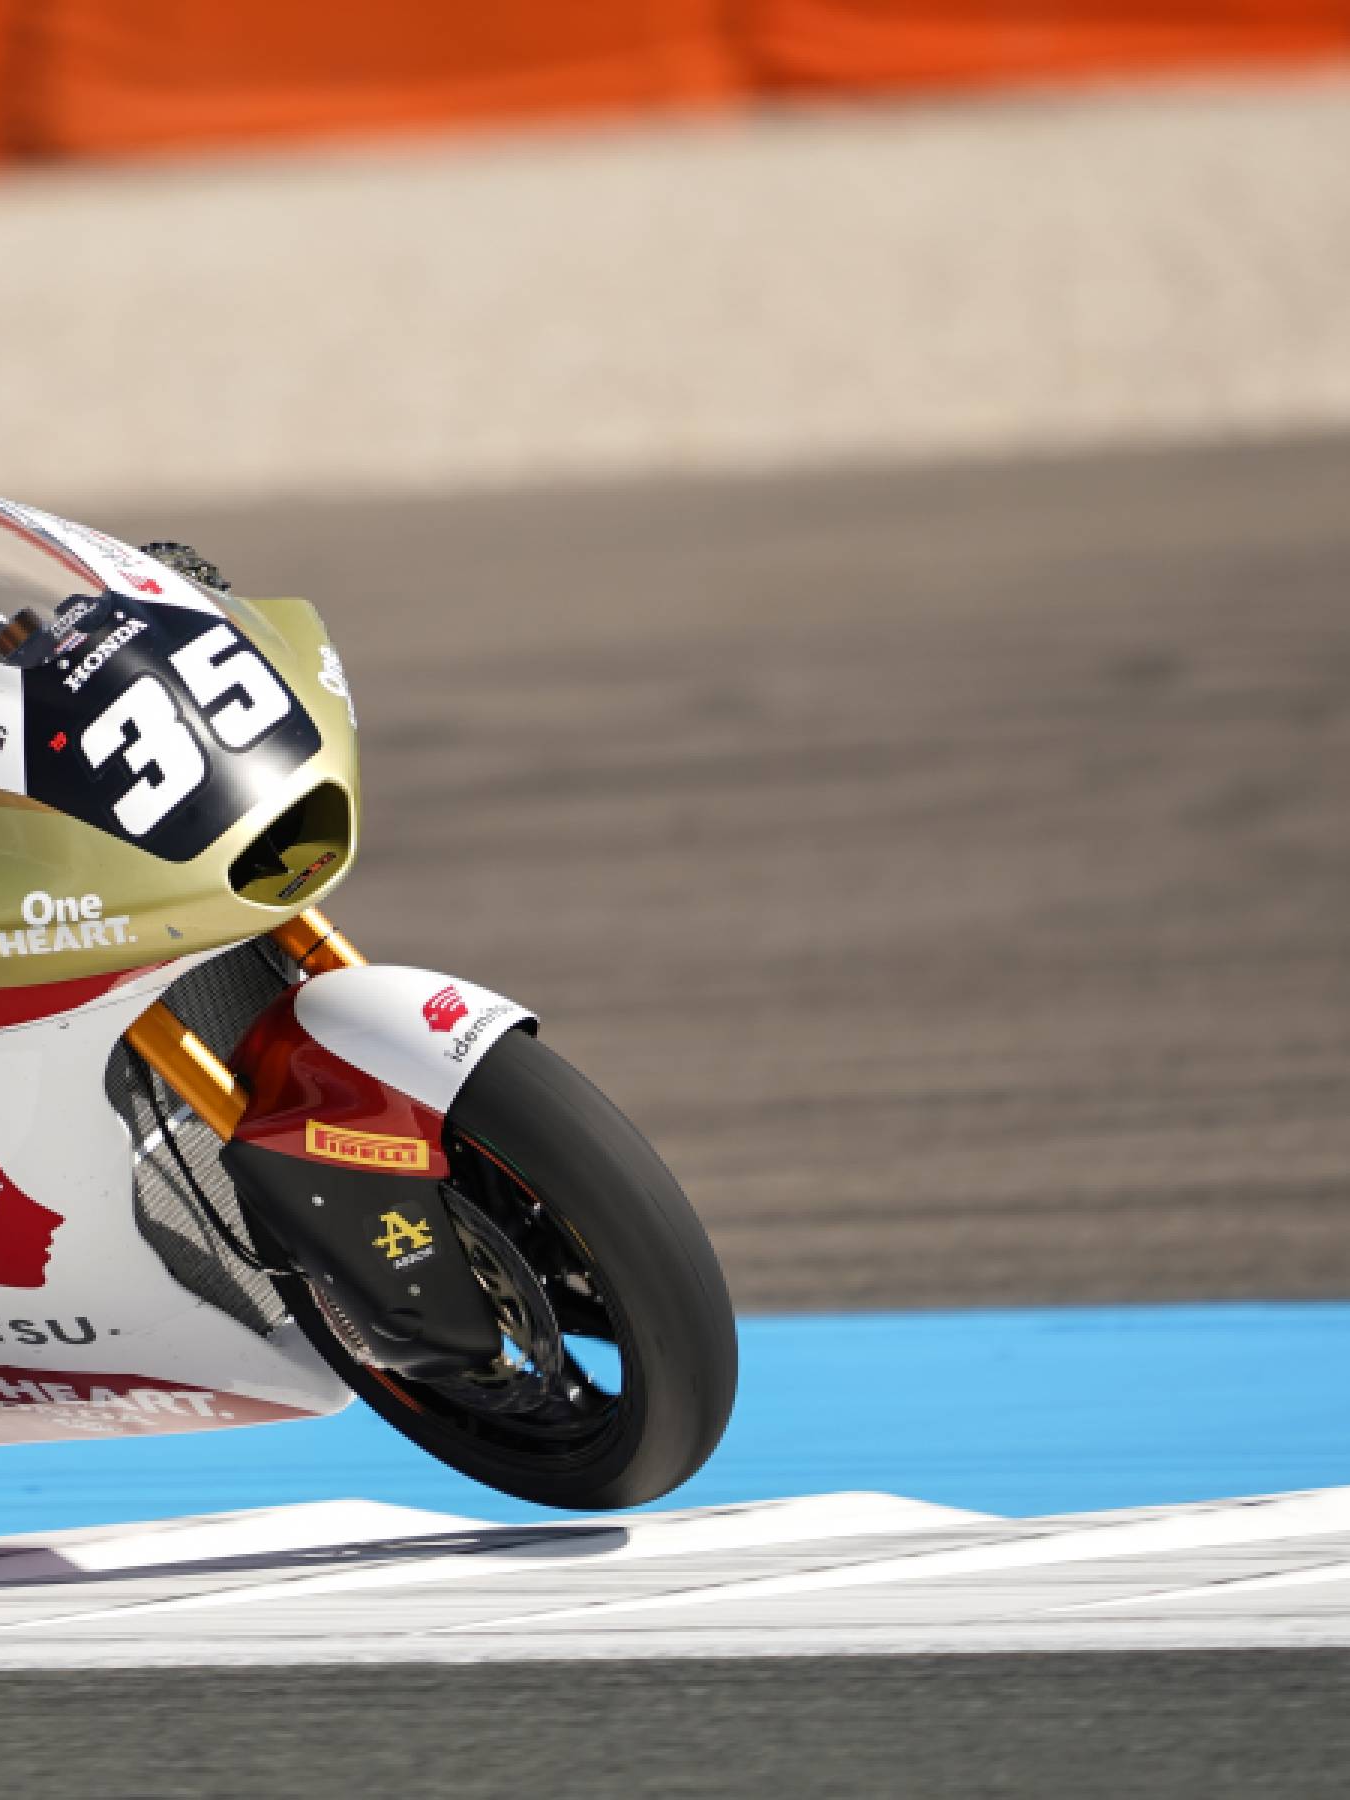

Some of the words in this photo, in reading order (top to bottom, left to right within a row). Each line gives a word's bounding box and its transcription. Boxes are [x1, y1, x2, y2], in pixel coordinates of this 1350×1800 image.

[62, 617, 149, 693] HONDA
[79, 622, 293, 838] 35
[20, 890, 103, 926] One
[314, 1128, 419, 1165] PIRELLI
